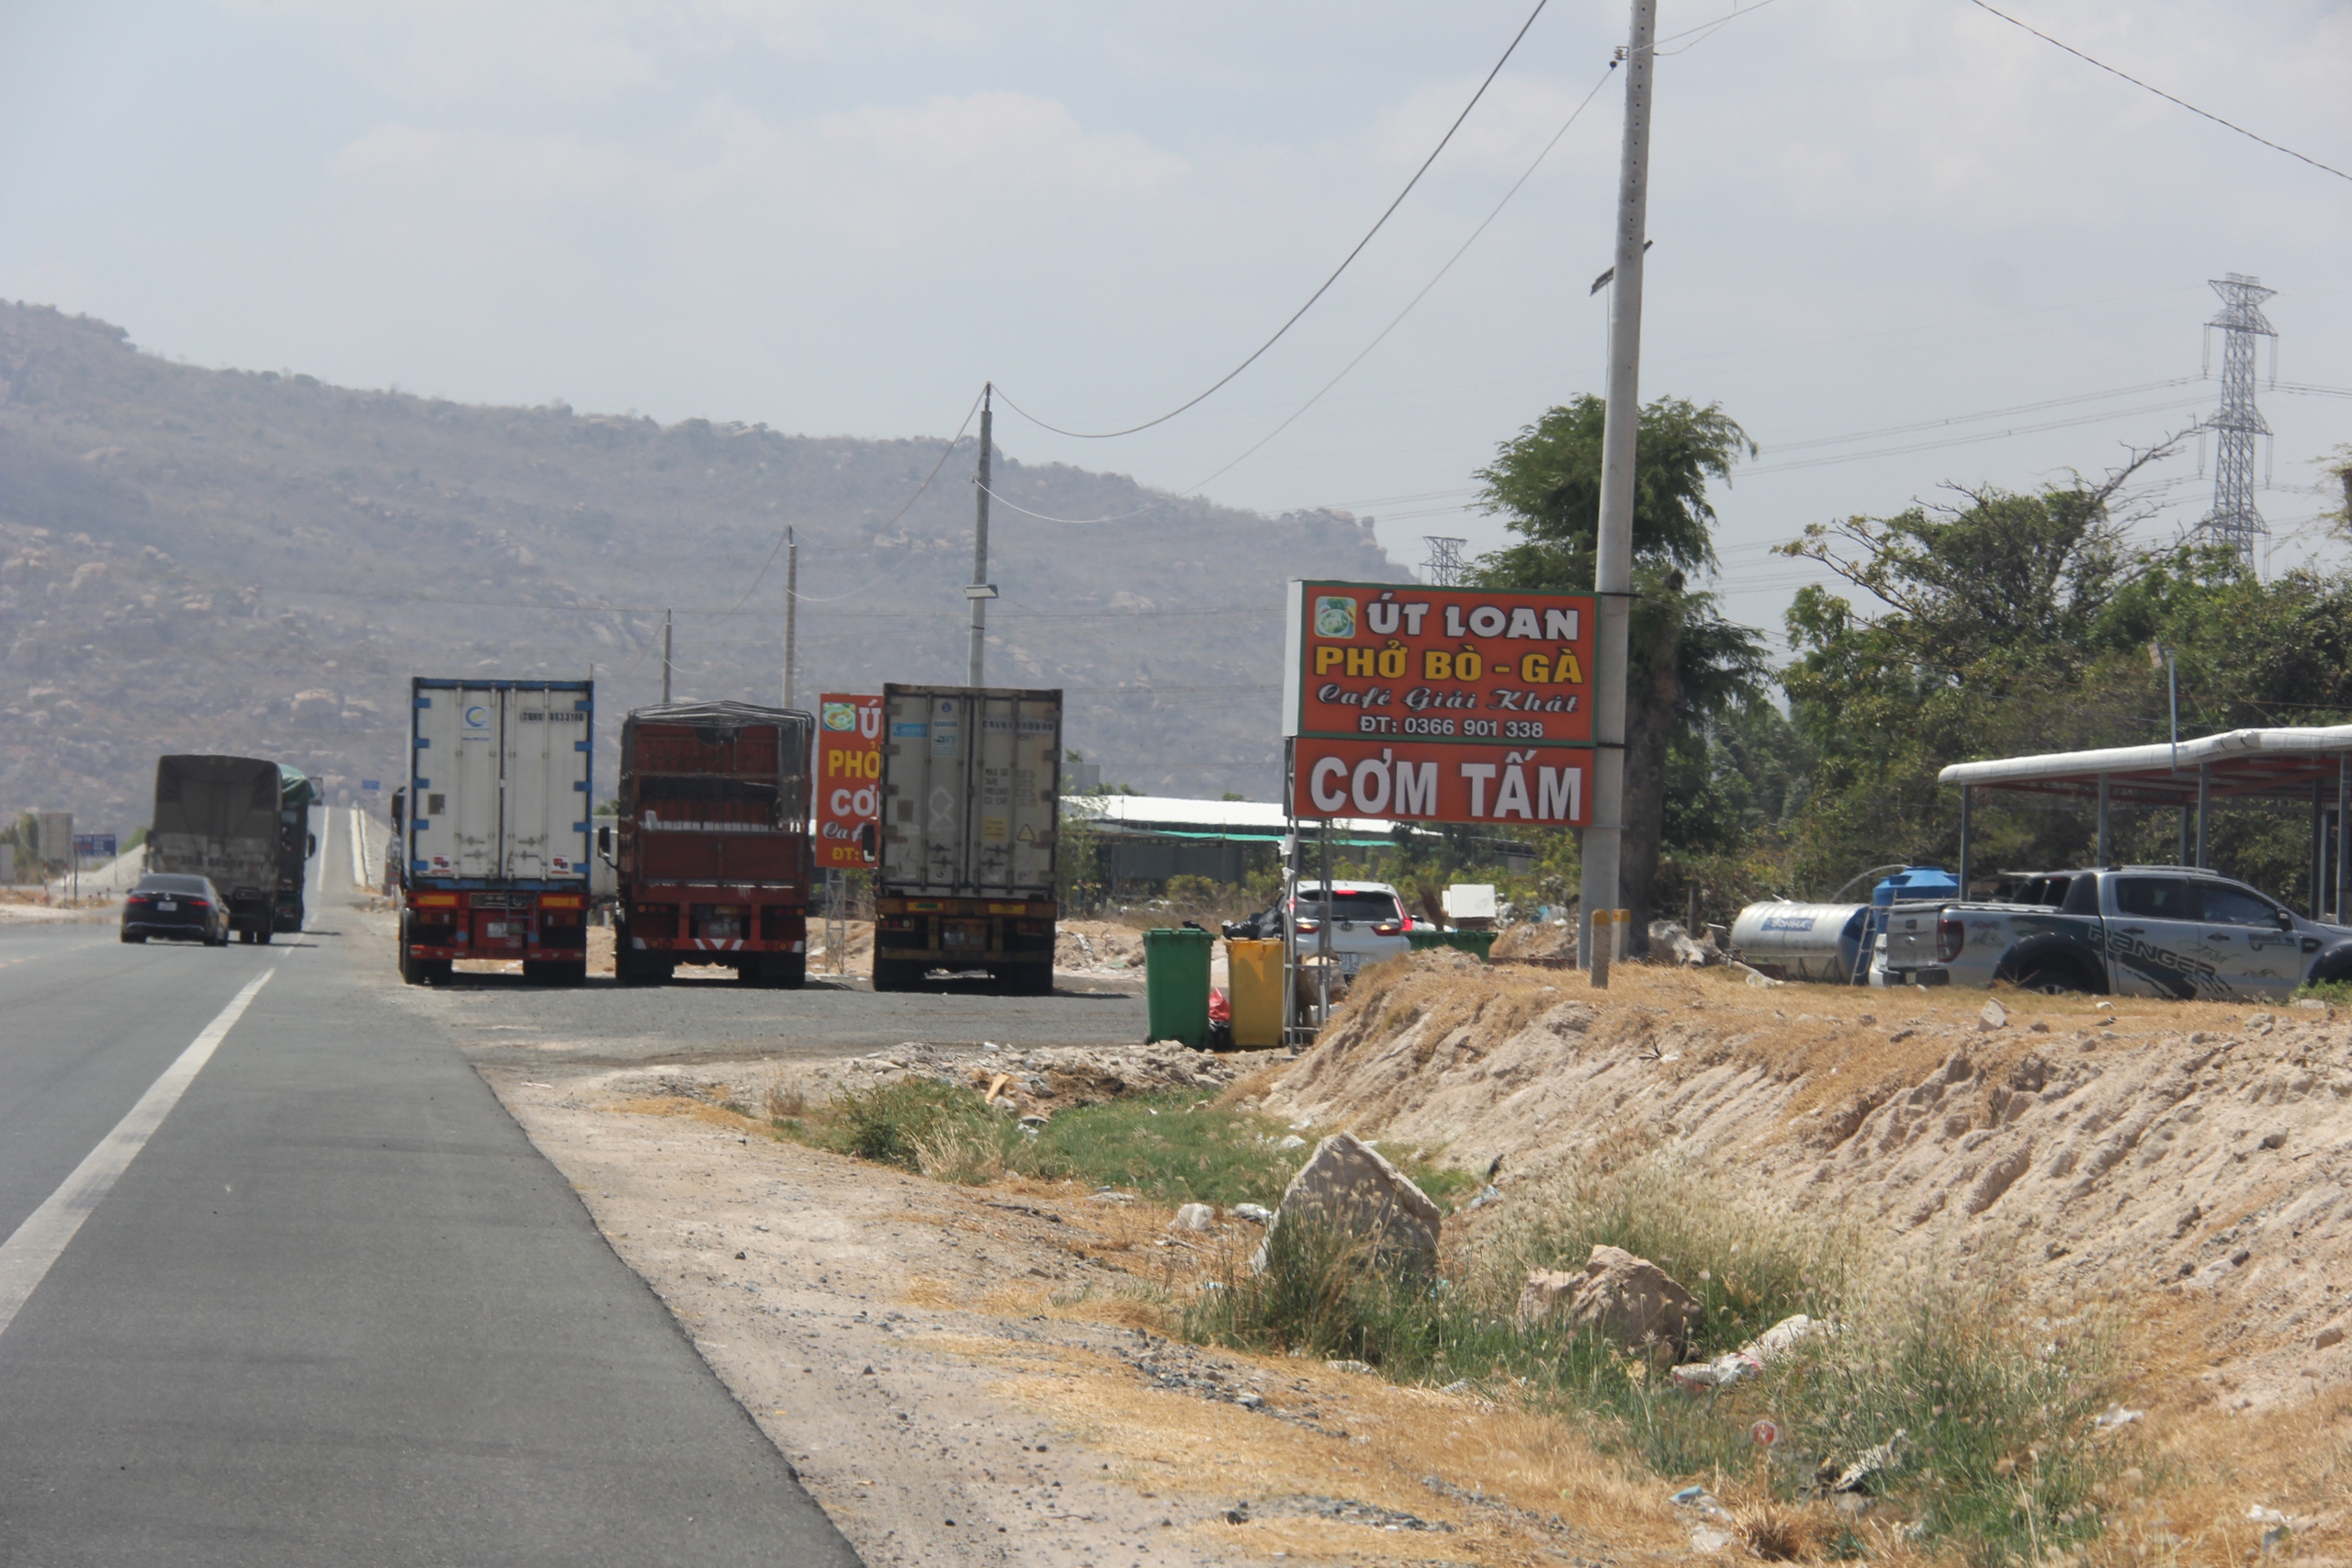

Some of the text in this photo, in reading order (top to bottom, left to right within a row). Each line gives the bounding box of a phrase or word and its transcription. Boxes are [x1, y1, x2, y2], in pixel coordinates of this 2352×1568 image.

[1366, 592, 1579, 641] ÚT LOAN
[1316, 639, 1408, 680] PHỞ
[1424, 645, 1483, 682] BÒ
[1521, 647, 1584, 684] GÀ
[1317, 682, 1578, 714] Café Giải Khát
[858, 699, 882, 739] Ú
[1359, 715, 1544, 739] ĐT: 0366 901 338
[830, 784, 880, 817] CƠ
[1309, 748, 1582, 821] CƠM TẤM
[821, 821, 864, 843] Caf
[2087, 924, 2217, 976] RANGER
